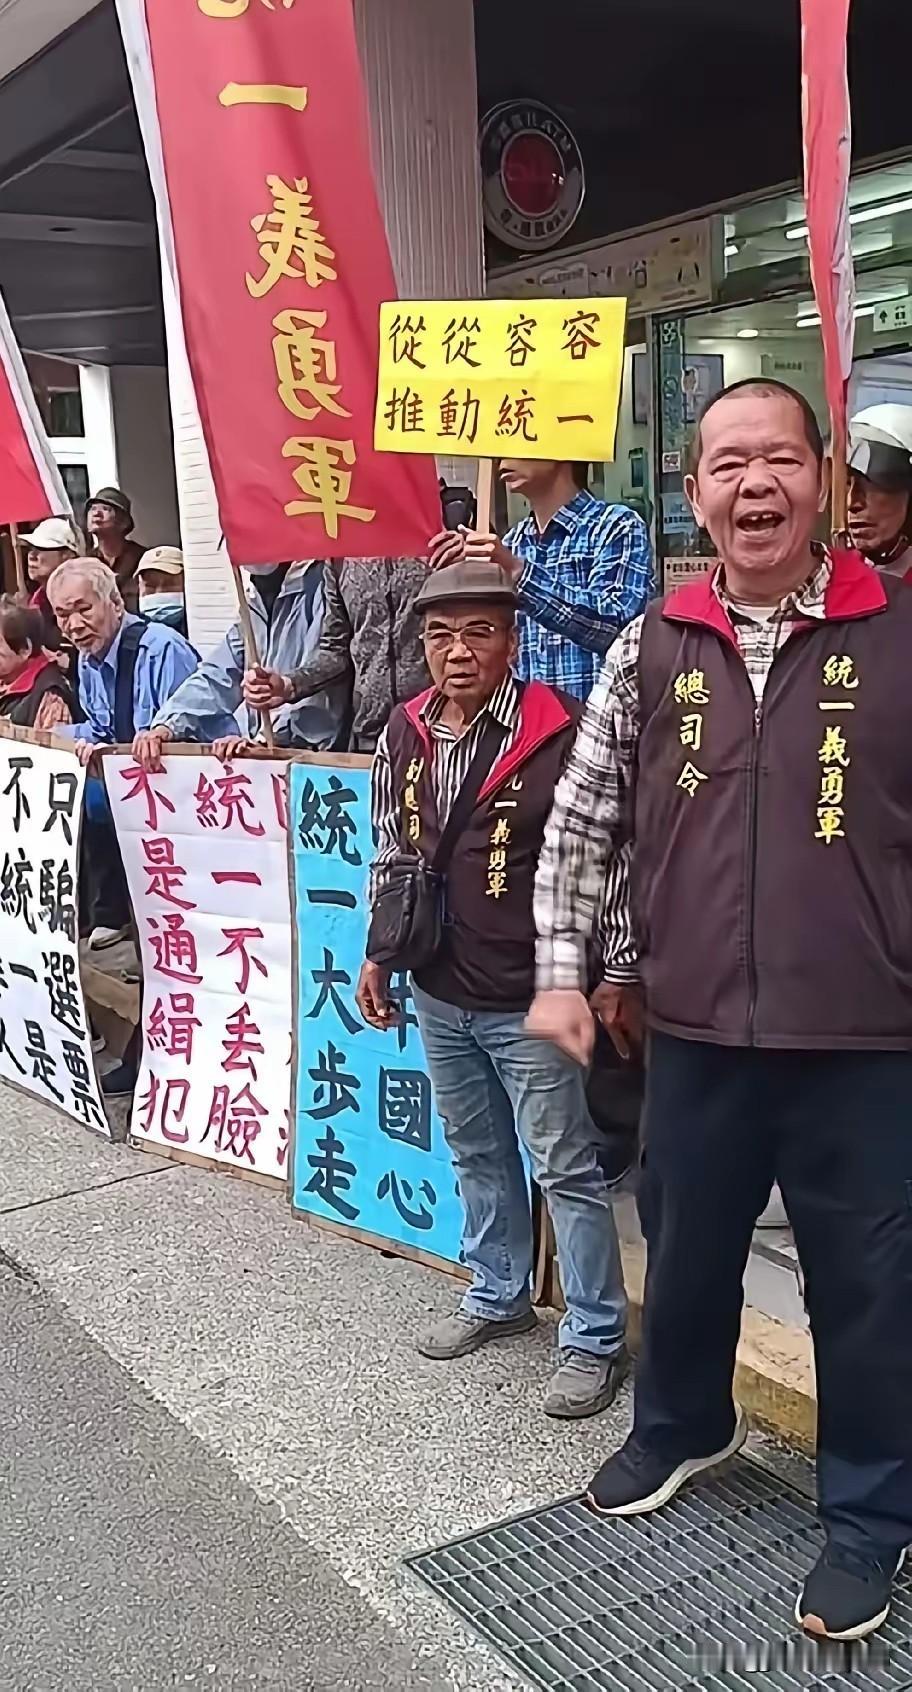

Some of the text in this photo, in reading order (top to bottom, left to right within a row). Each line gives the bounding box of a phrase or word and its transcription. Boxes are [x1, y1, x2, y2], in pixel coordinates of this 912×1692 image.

[383, 386, 594, 443] 推動統一
[388, 310, 601, 370] 從從容容
[673, 667, 711, 798] 總司令
[814, 655, 860, 845] 統一義勇軍
[0, 757, 65, 1104] 不統一是
[37, 772, 105, 1129] 只騙選票
[118, 762, 203, 1144] 不是通緝犯
[193, 765, 270, 1166] 統一不丟臉
[298, 775, 365, 1222] 統一大步走
